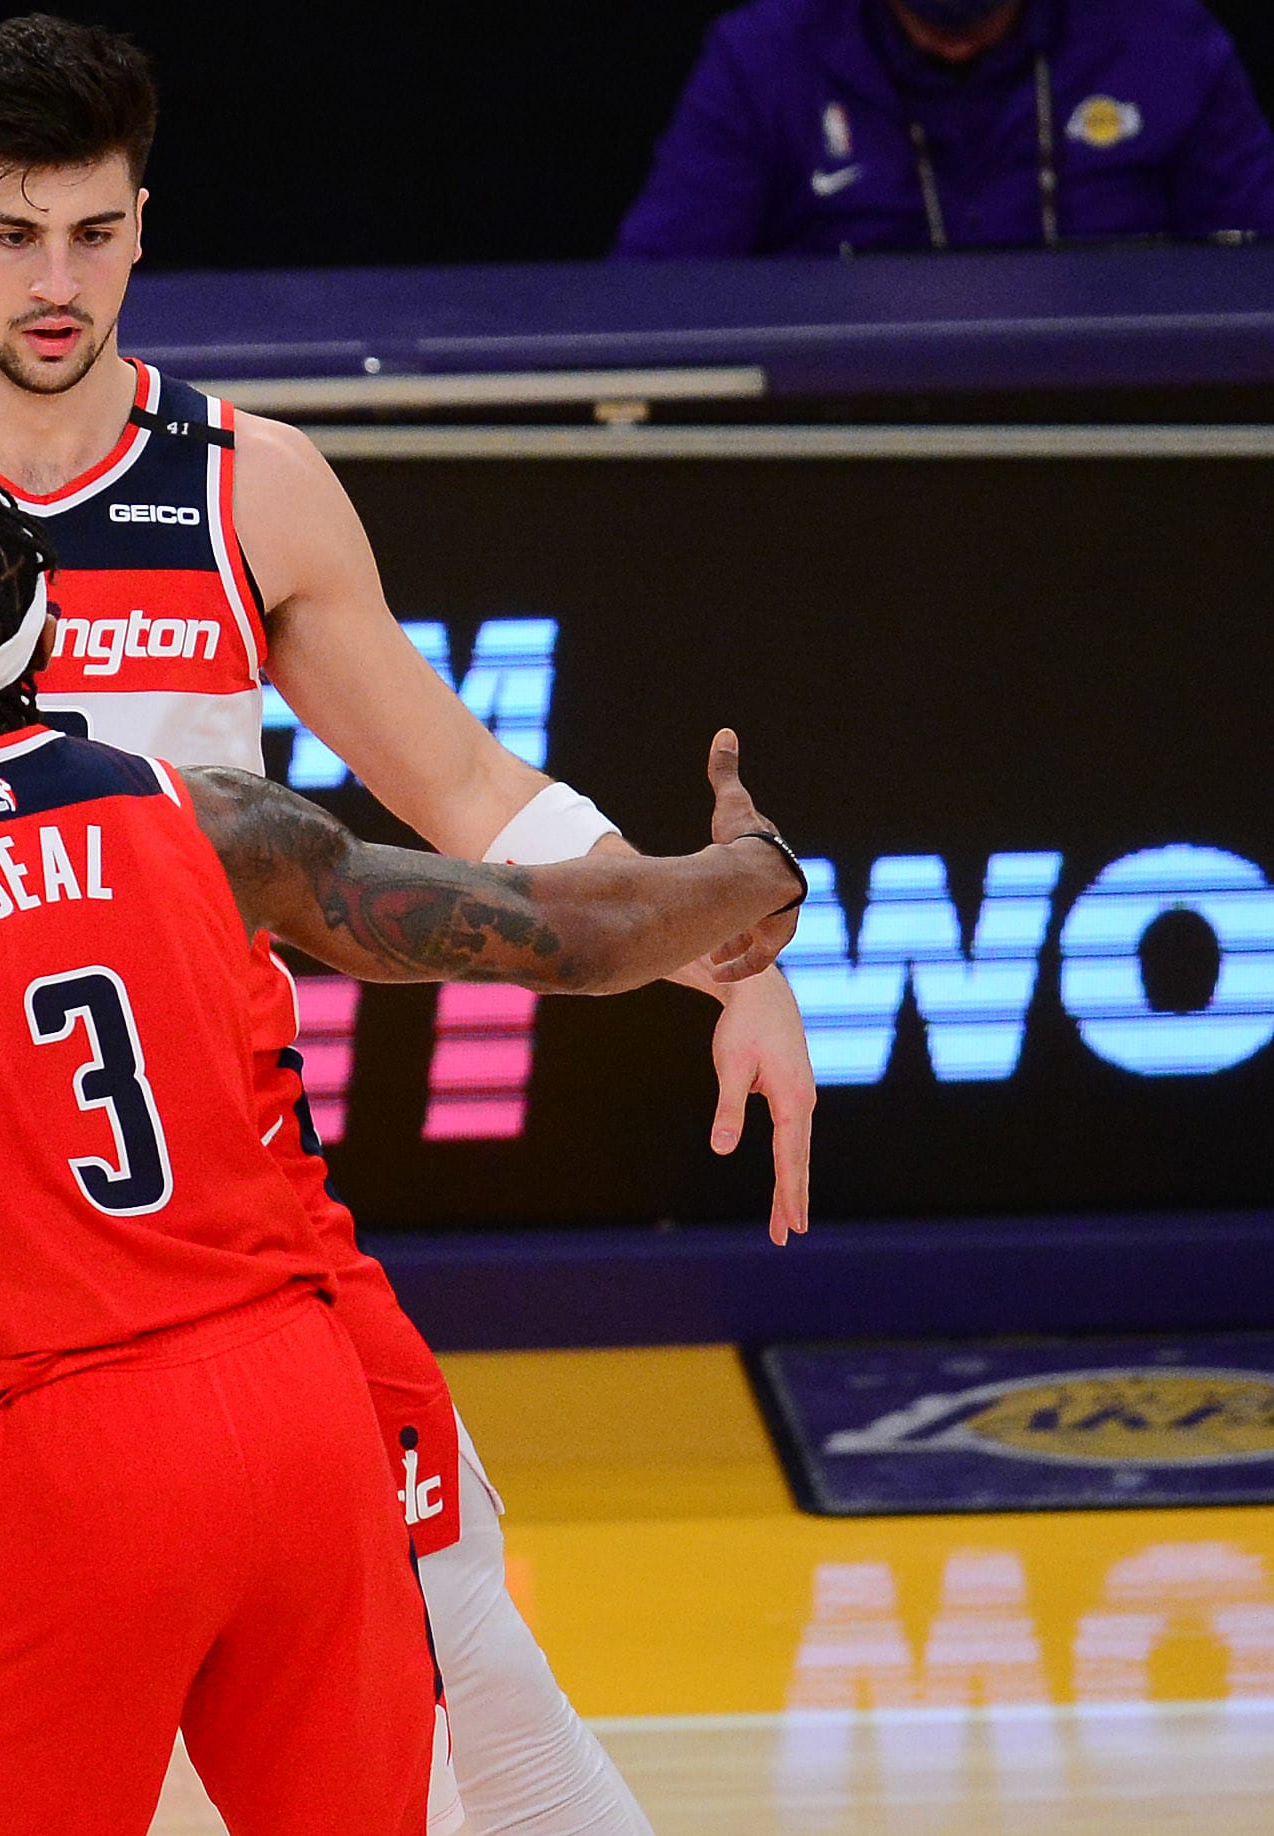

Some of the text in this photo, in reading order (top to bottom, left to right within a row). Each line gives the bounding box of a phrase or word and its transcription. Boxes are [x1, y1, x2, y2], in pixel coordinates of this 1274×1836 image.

[166, 421, 189, 435] 41
[109, 503, 200, 526] GEICO
[24, 965, 173, 1216] 3
